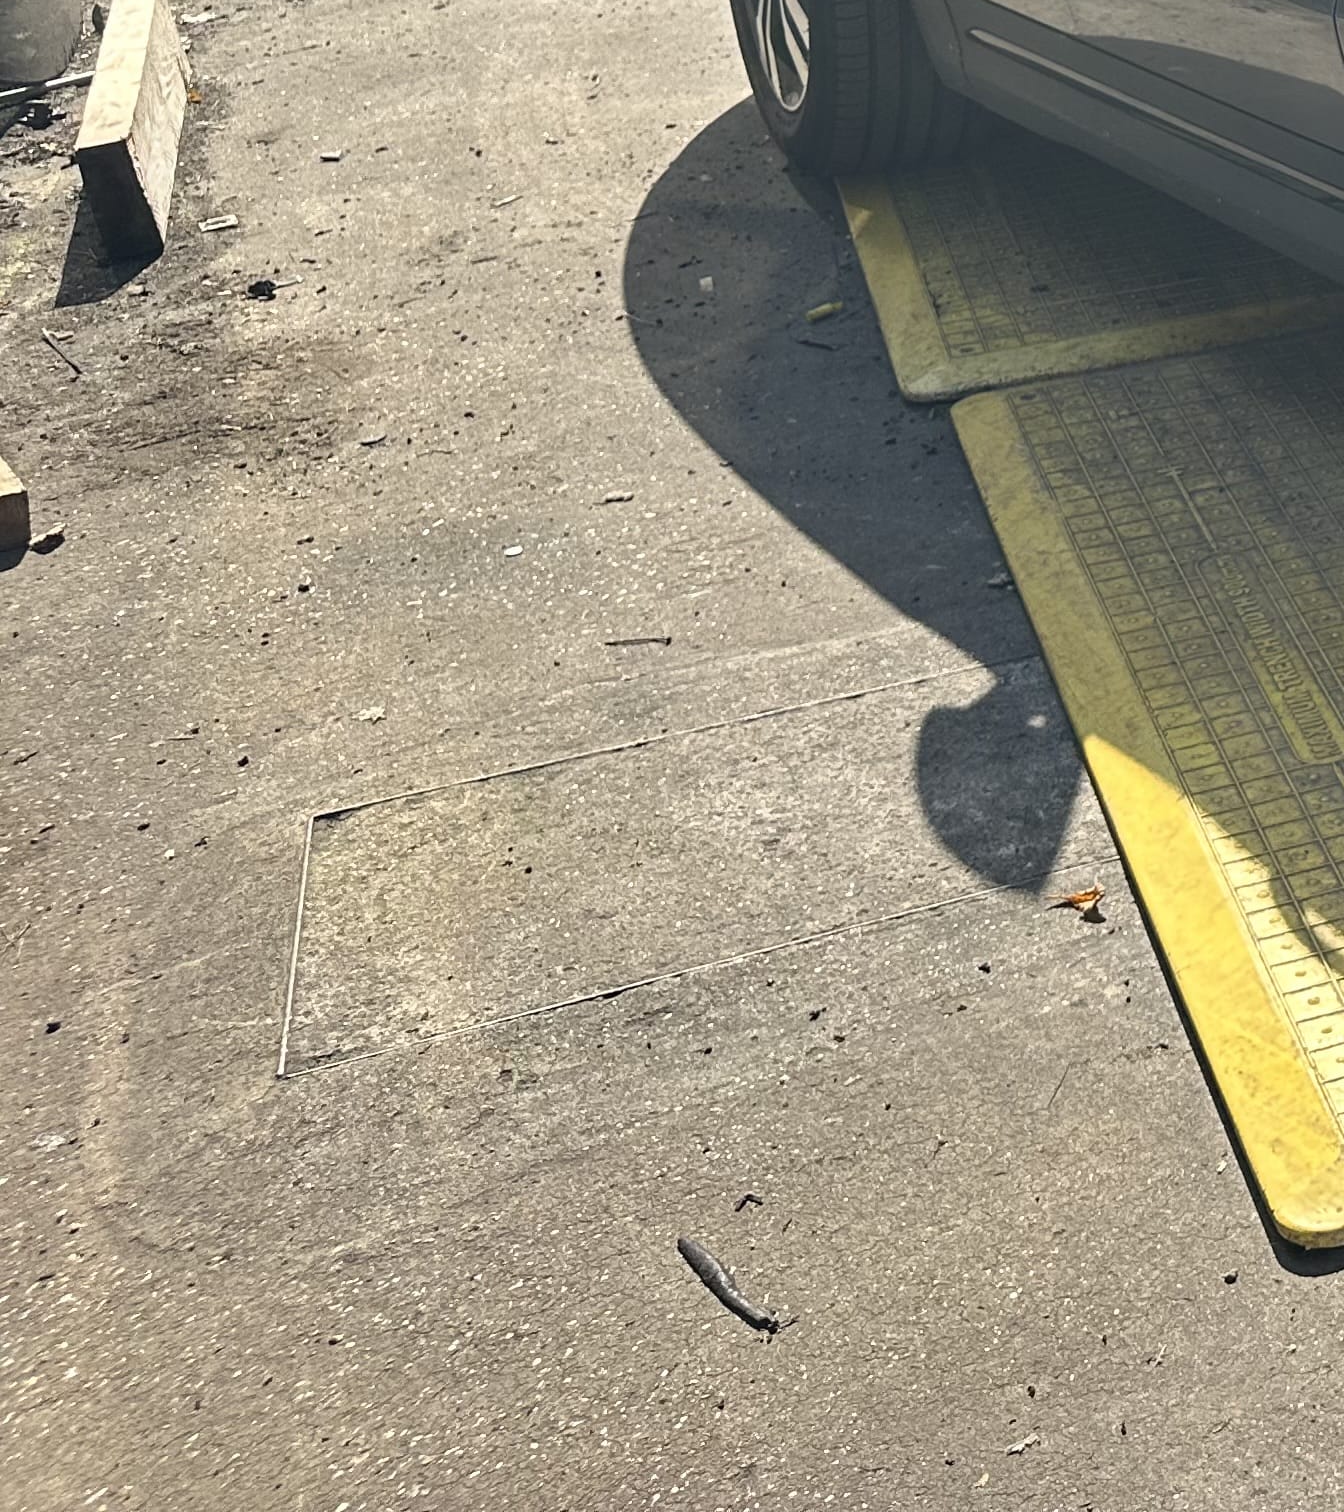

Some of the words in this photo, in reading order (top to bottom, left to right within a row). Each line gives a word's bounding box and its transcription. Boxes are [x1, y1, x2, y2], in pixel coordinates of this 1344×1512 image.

[1234, 599, 1273, 637] WIDTH
[1255, 639, 1303, 693] TRENCH
[1285, 691, 1342, 761] MAXIMUM
